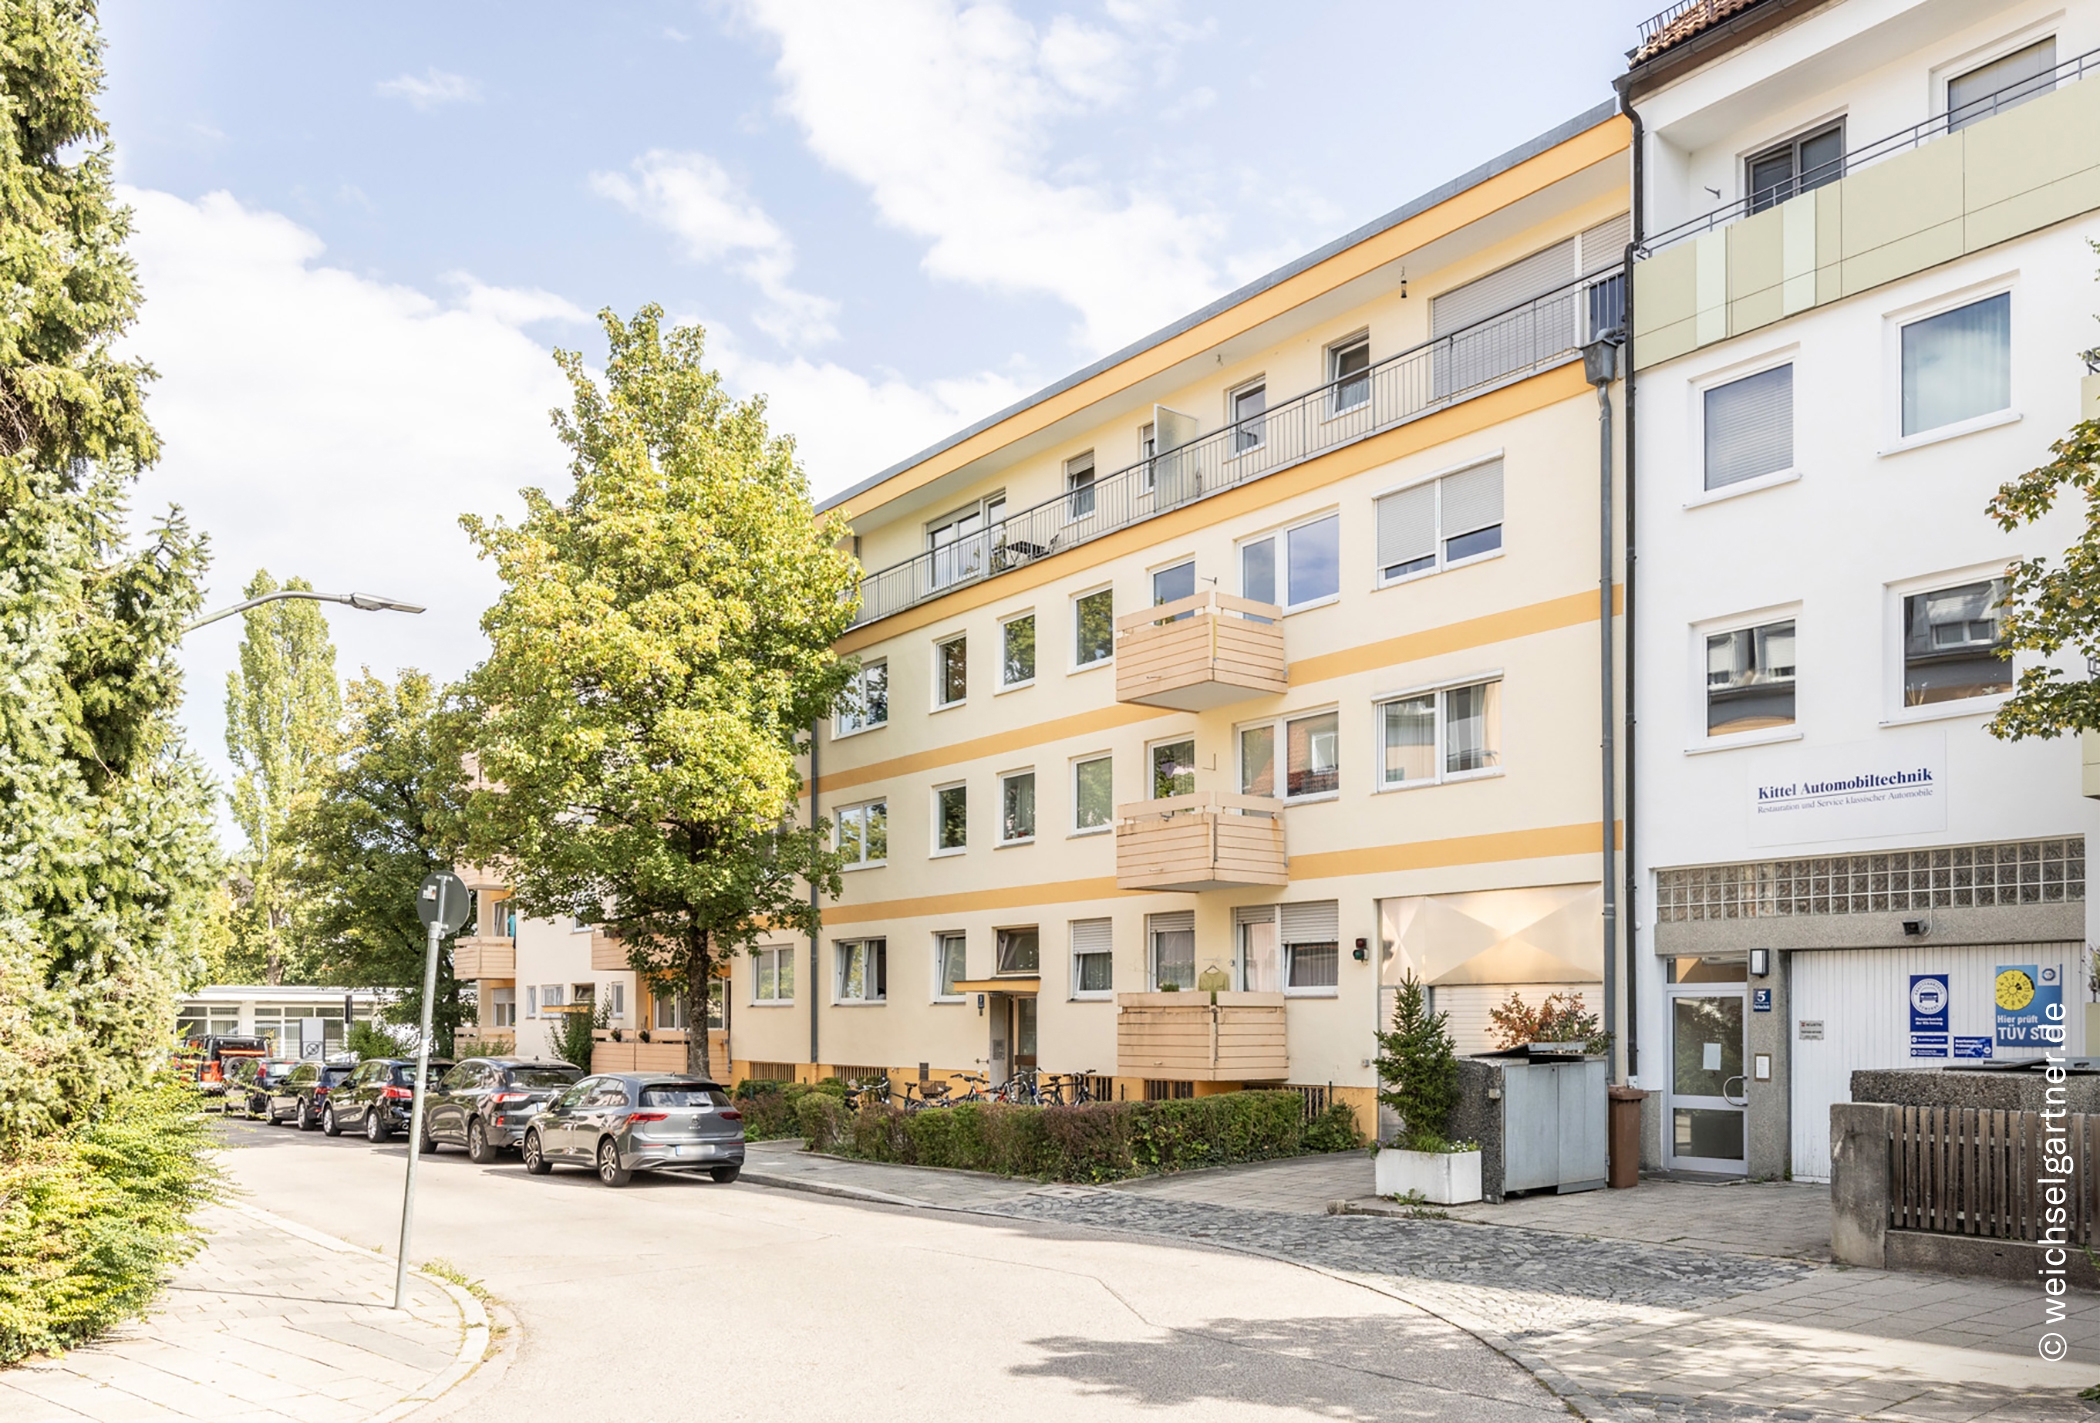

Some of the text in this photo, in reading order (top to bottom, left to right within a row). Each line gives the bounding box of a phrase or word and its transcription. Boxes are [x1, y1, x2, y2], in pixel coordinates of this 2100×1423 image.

[1758, 768, 1933, 800] Kittel Automobiltechnik
[1757, 787, 1933, 814] Restauration und Service klassischer Automobile
[1757, 990, 1766, 1002] 5
[1997, 1015, 2038, 1025] Hier prüft
[1997, 1024, 2027, 1040] TÜV
